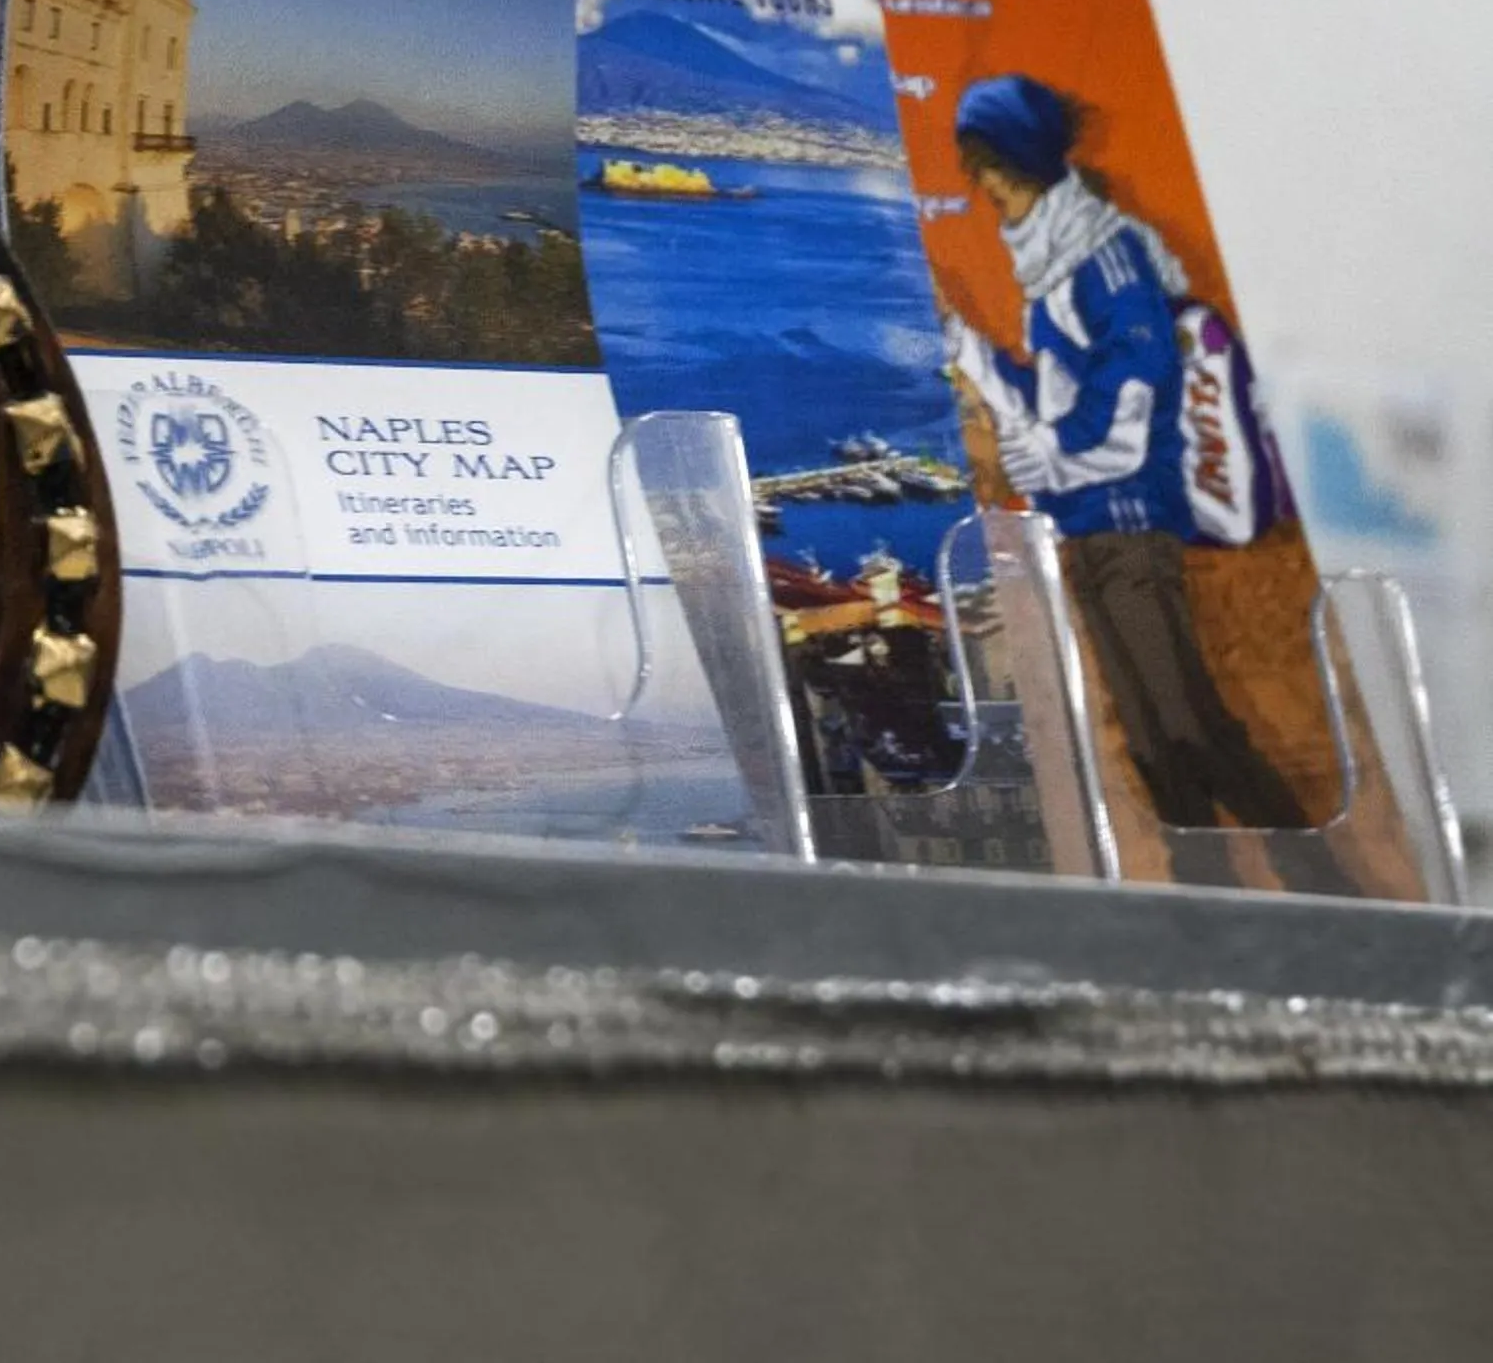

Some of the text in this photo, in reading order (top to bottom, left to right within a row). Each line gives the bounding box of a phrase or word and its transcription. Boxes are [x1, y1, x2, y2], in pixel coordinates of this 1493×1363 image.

[313, 415, 494, 447] NAPLES
[325, 449, 557, 481] CITY MAP
[336, 490, 478, 517] Itineraries
[348, 522, 562, 548] and information
